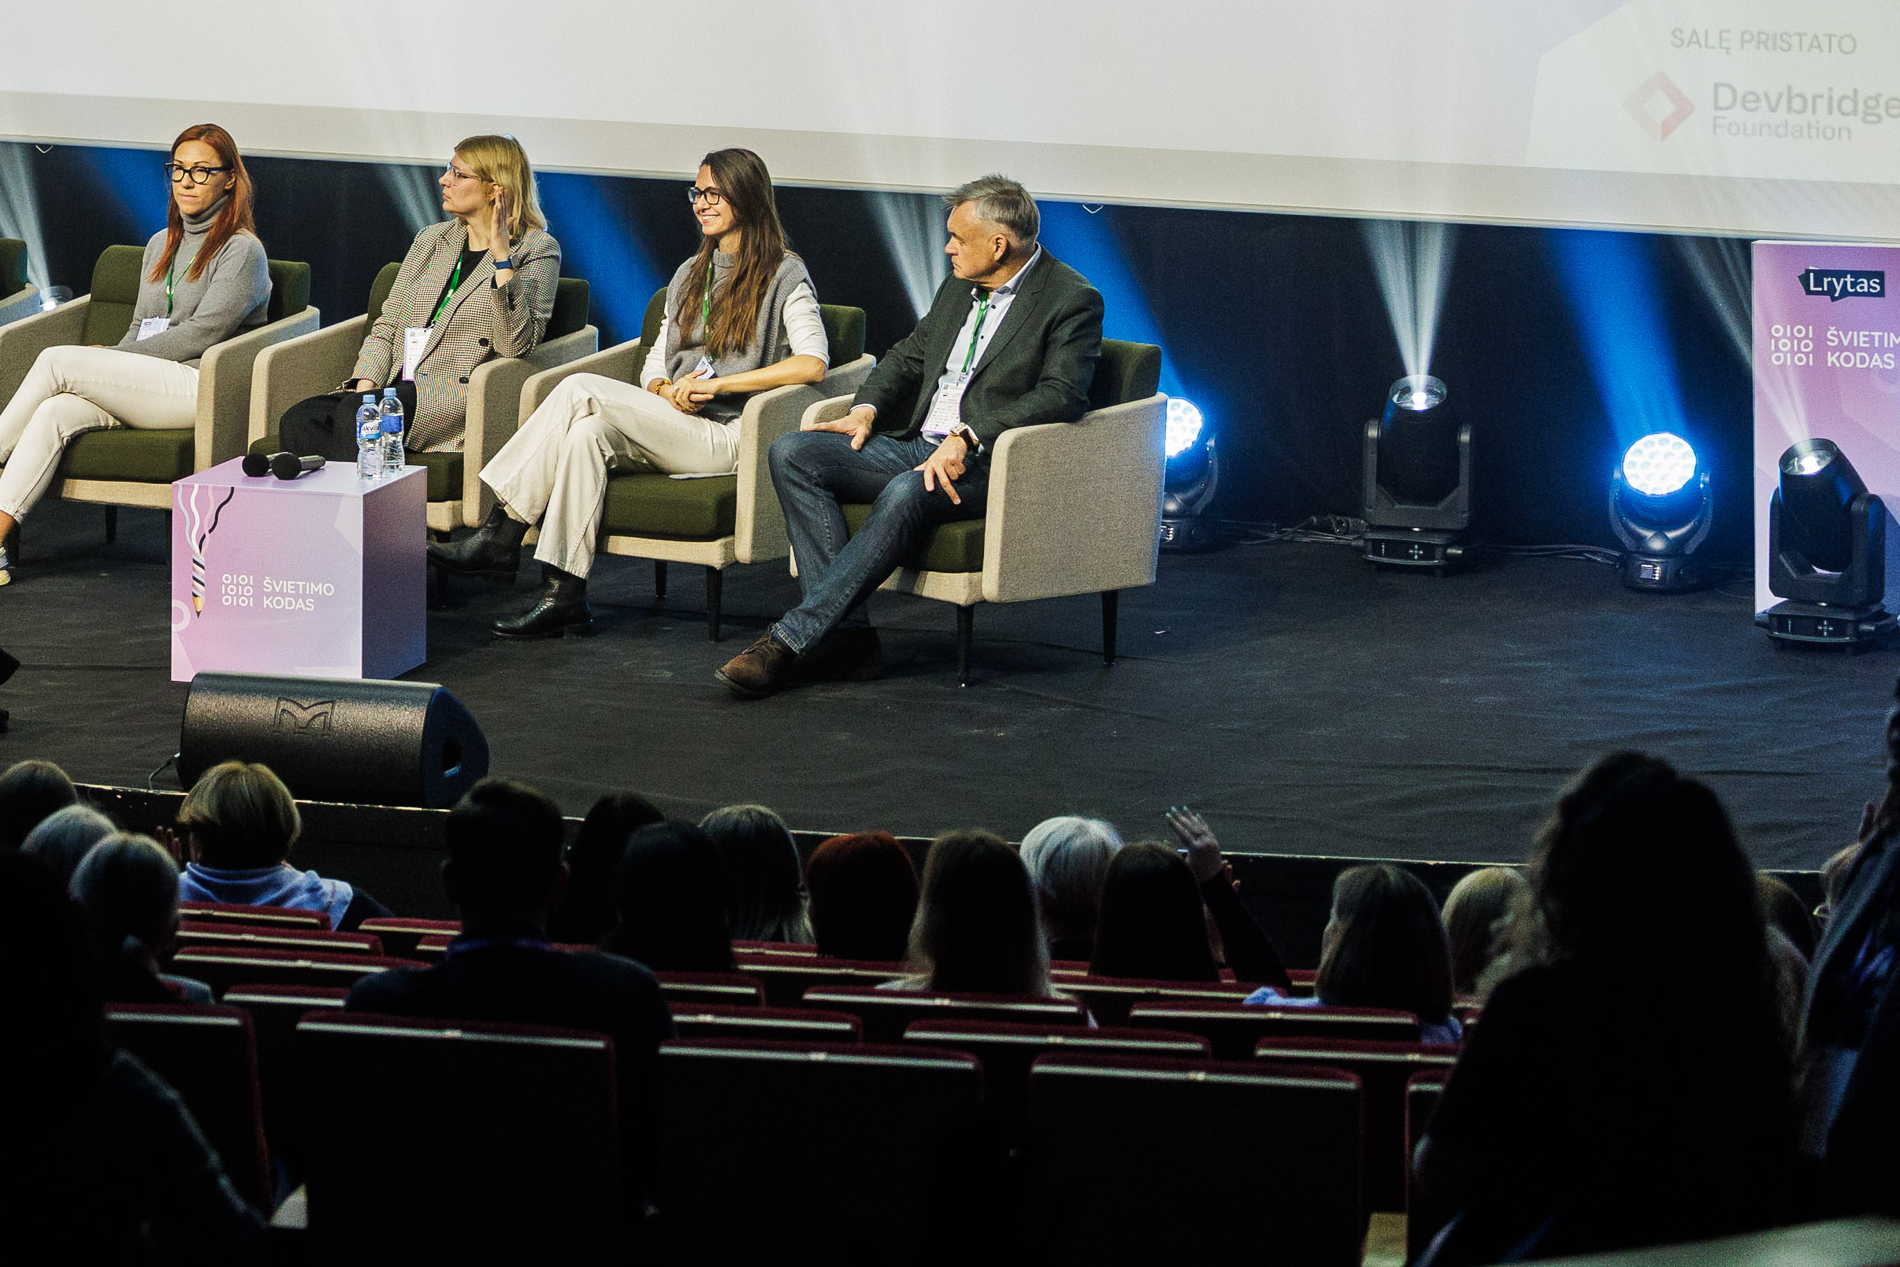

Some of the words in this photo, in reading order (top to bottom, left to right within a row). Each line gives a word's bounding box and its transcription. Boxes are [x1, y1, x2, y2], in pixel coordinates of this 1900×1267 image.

[1670, 27, 1732, 55] SALĘ
[1740, 30, 1857, 55] PRISTATO
[1712, 81, 1900, 124] Devbridge
[1712, 115, 1852, 141] Foundation
[1809, 272, 1881, 297] Lrytas
[1827, 351, 1895, 370] KODAS
[263, 576, 335, 596] ŠVIETIMO
[263, 596, 315, 611] KODAS
